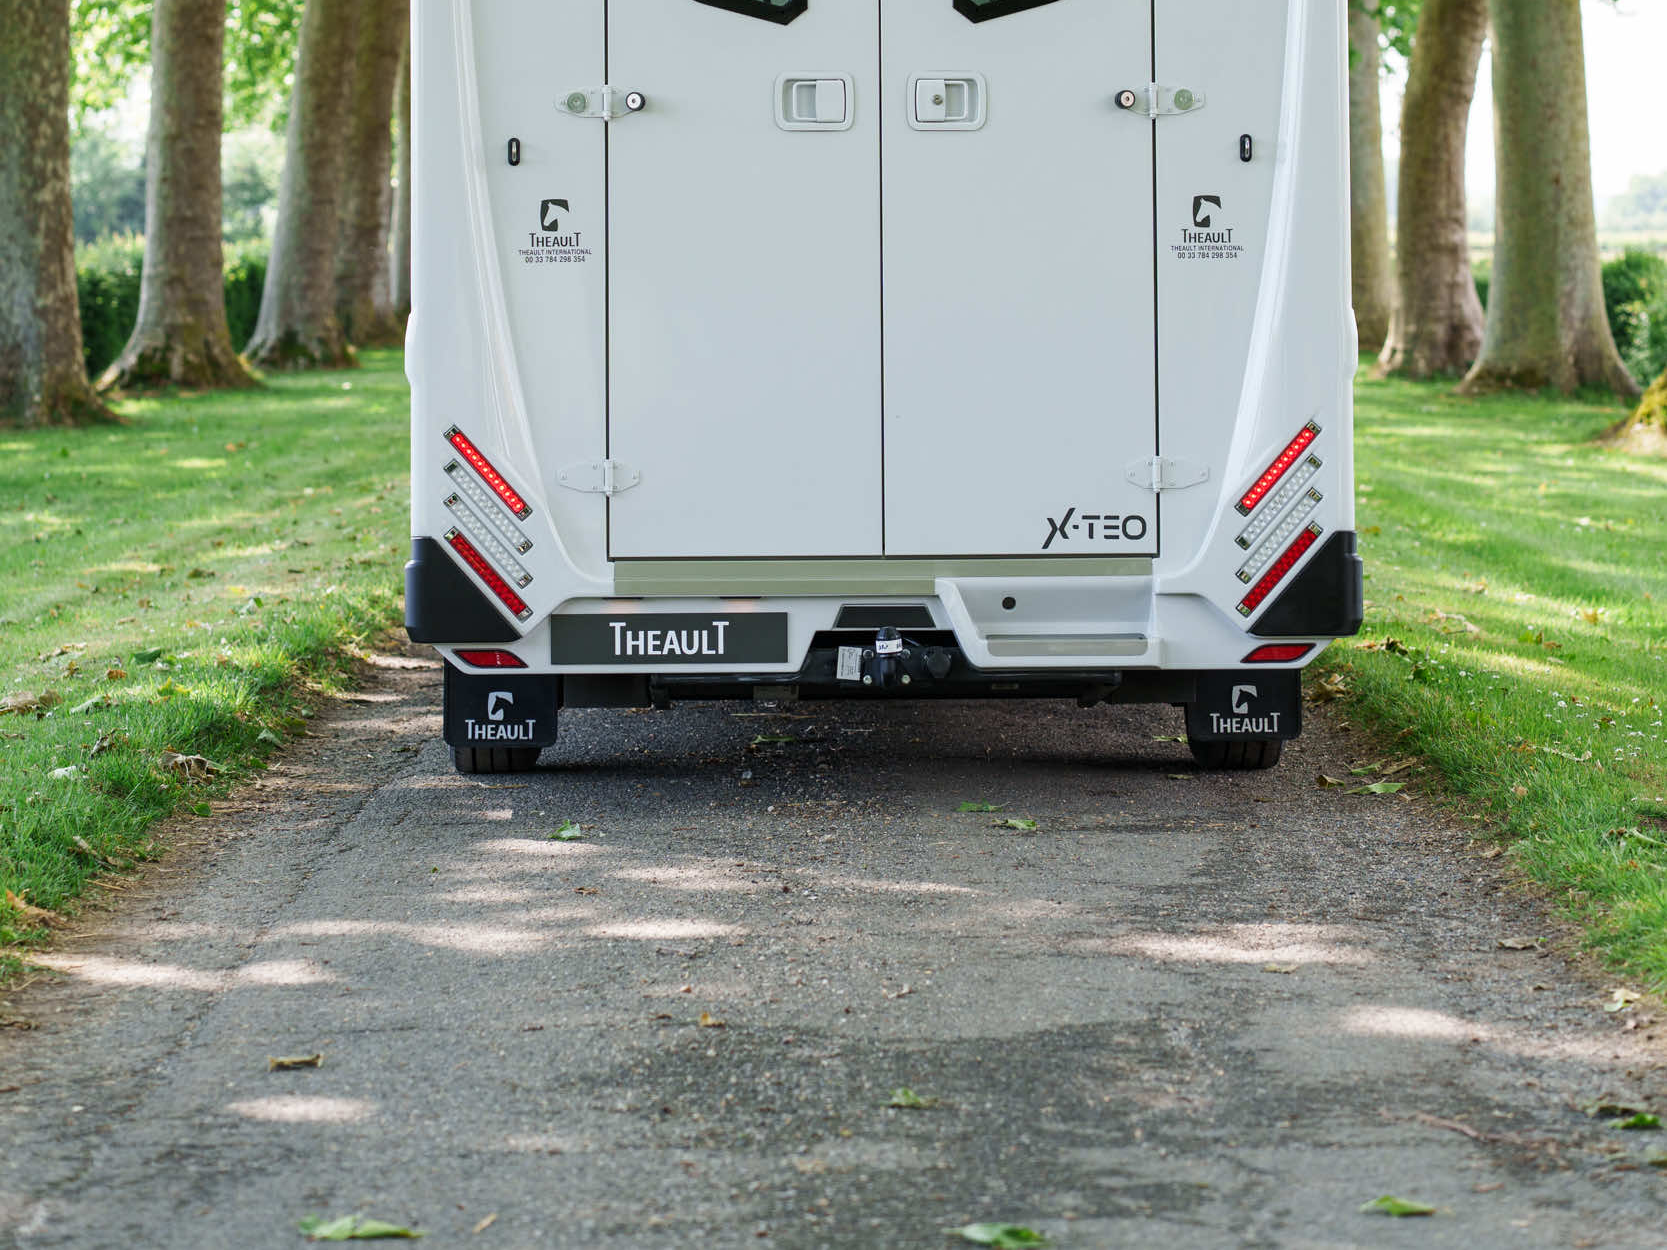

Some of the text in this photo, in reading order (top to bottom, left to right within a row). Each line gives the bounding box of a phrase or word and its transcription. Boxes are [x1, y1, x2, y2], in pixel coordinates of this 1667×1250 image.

[529, 232, 581, 247] THEAULT
[1181, 229, 1233, 243] THEAULT
[1041, 507, 1147, 549] X-TEO
[609, 621, 729, 655] THEAULT
[465, 719, 536, 740] THEAULT
[1209, 713, 1281, 733] THEAULT
